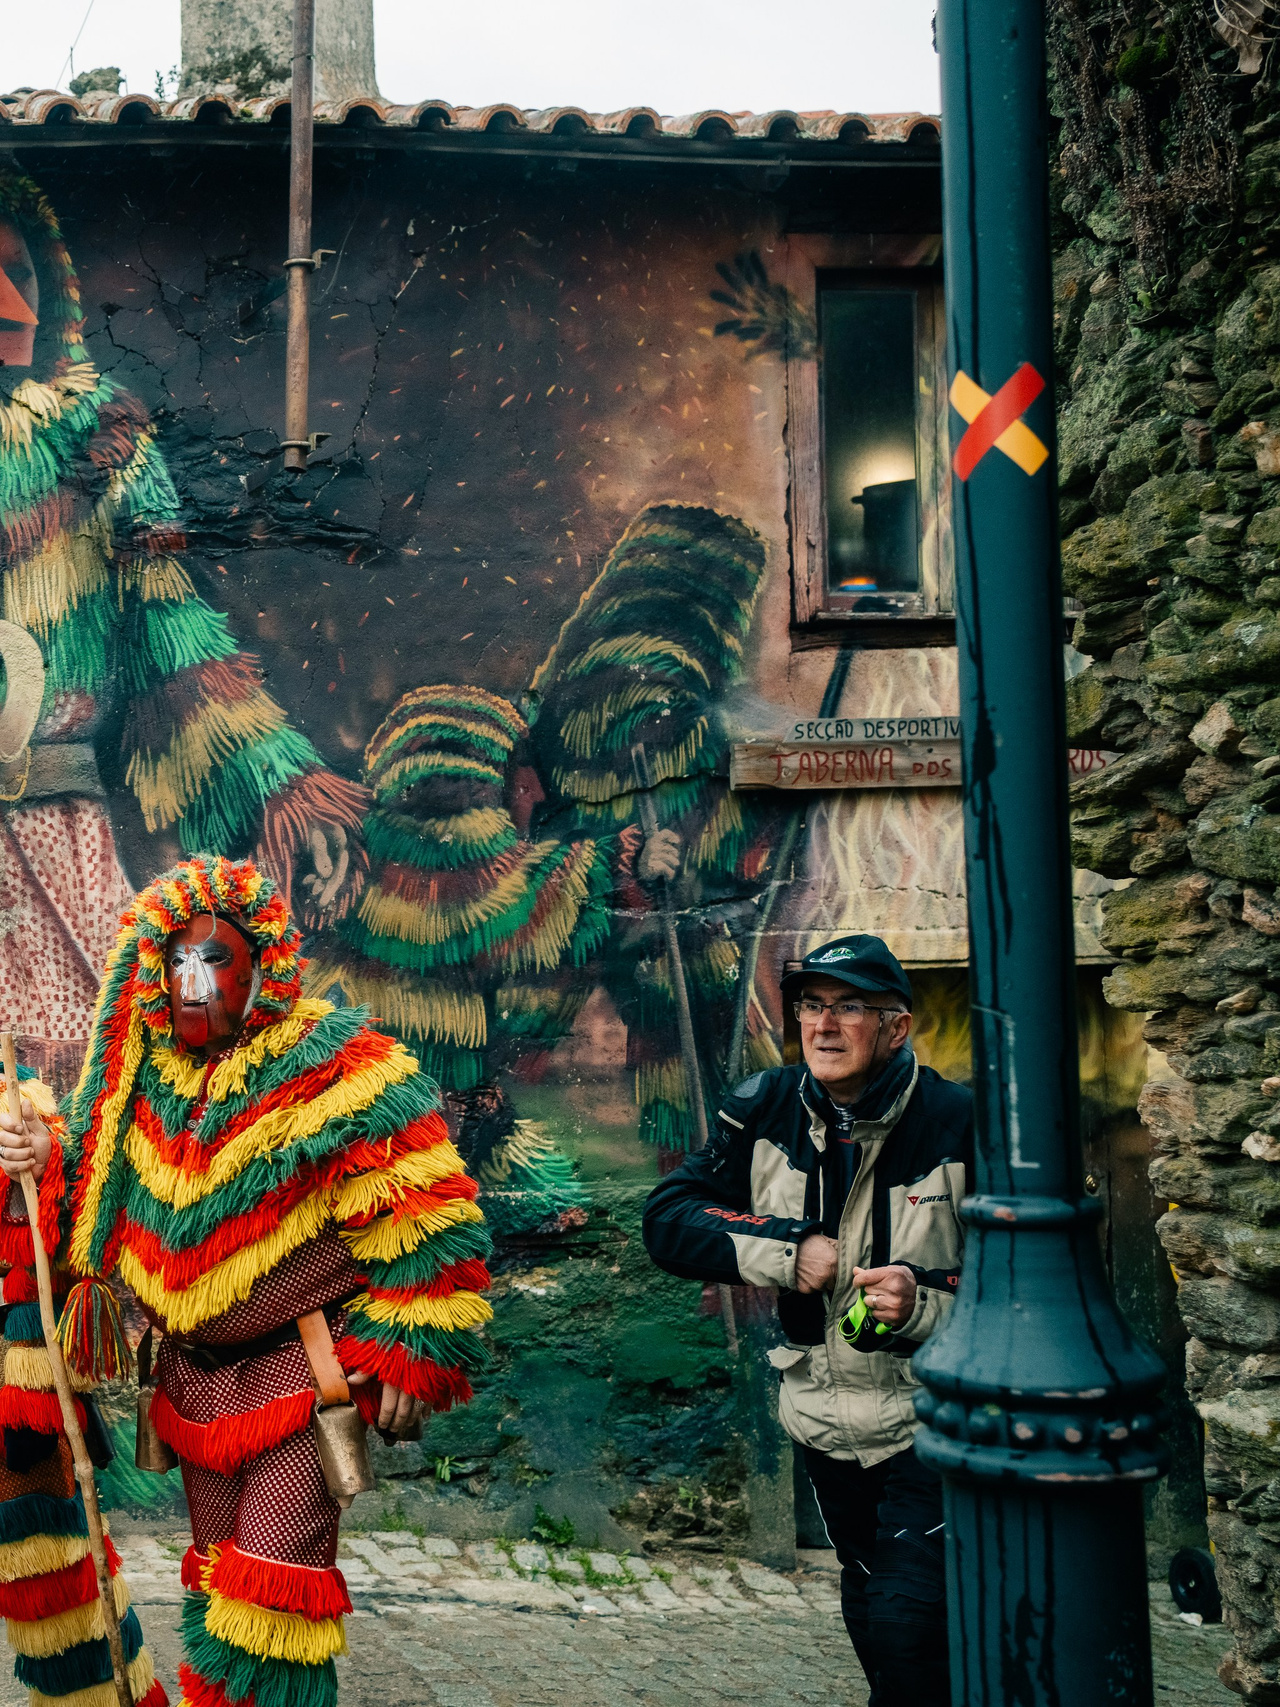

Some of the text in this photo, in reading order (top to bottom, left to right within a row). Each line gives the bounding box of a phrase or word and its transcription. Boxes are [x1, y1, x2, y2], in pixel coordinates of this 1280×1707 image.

[795, 718, 961, 741] SECÇÃO DESPORTIV
[769, 748, 951, 785] TABERNA DOS
[919, 1194, 950, 1204] DAINES
